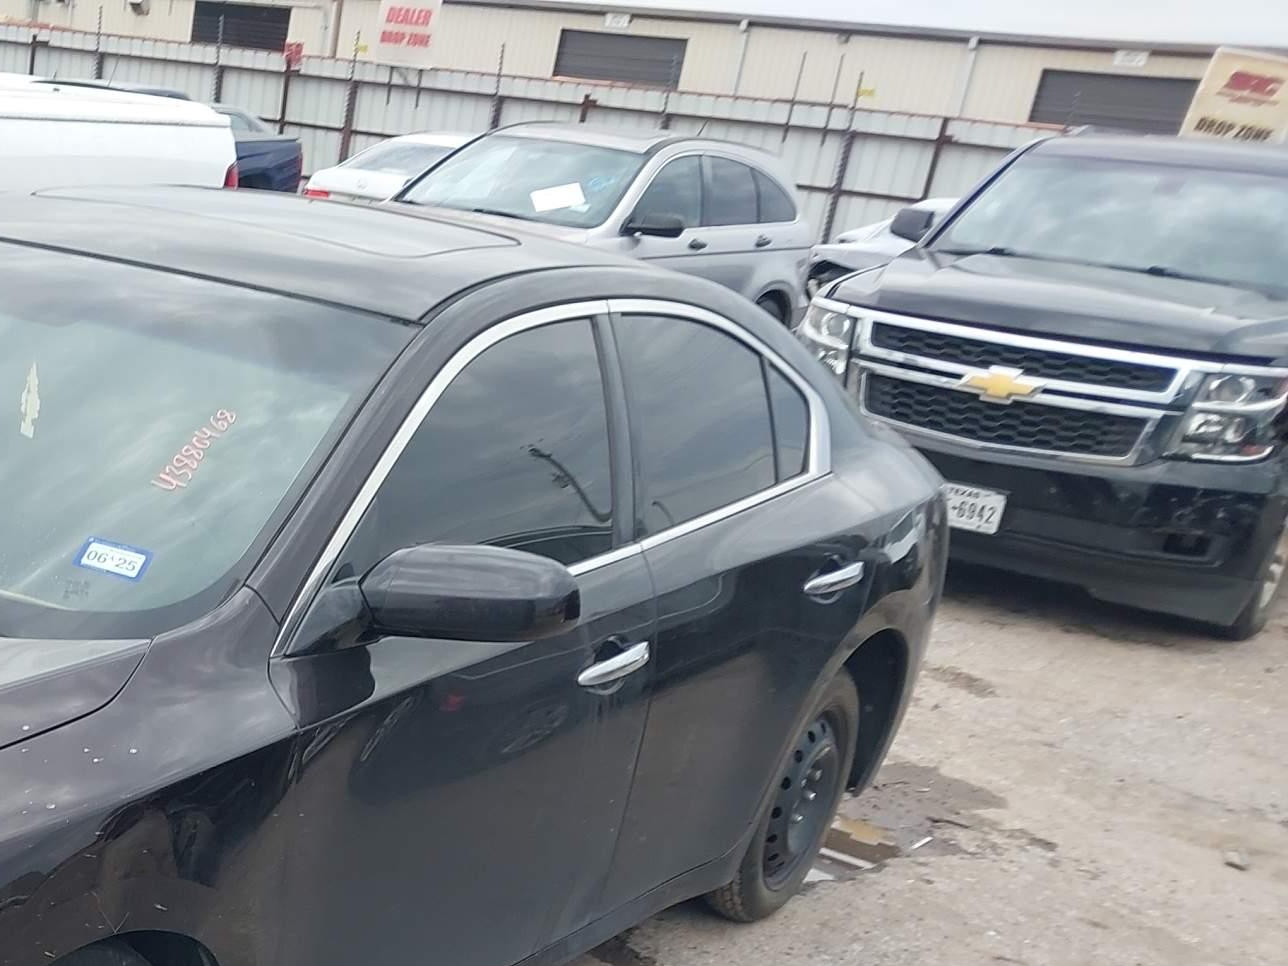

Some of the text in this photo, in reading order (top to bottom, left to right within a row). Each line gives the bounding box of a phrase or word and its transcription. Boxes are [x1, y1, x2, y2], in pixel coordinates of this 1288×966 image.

[385, 6, 433, 26] DEALER
[1193, 117, 1274, 142] DROP ZONE
[150, 408, 236, 491] 43880468
